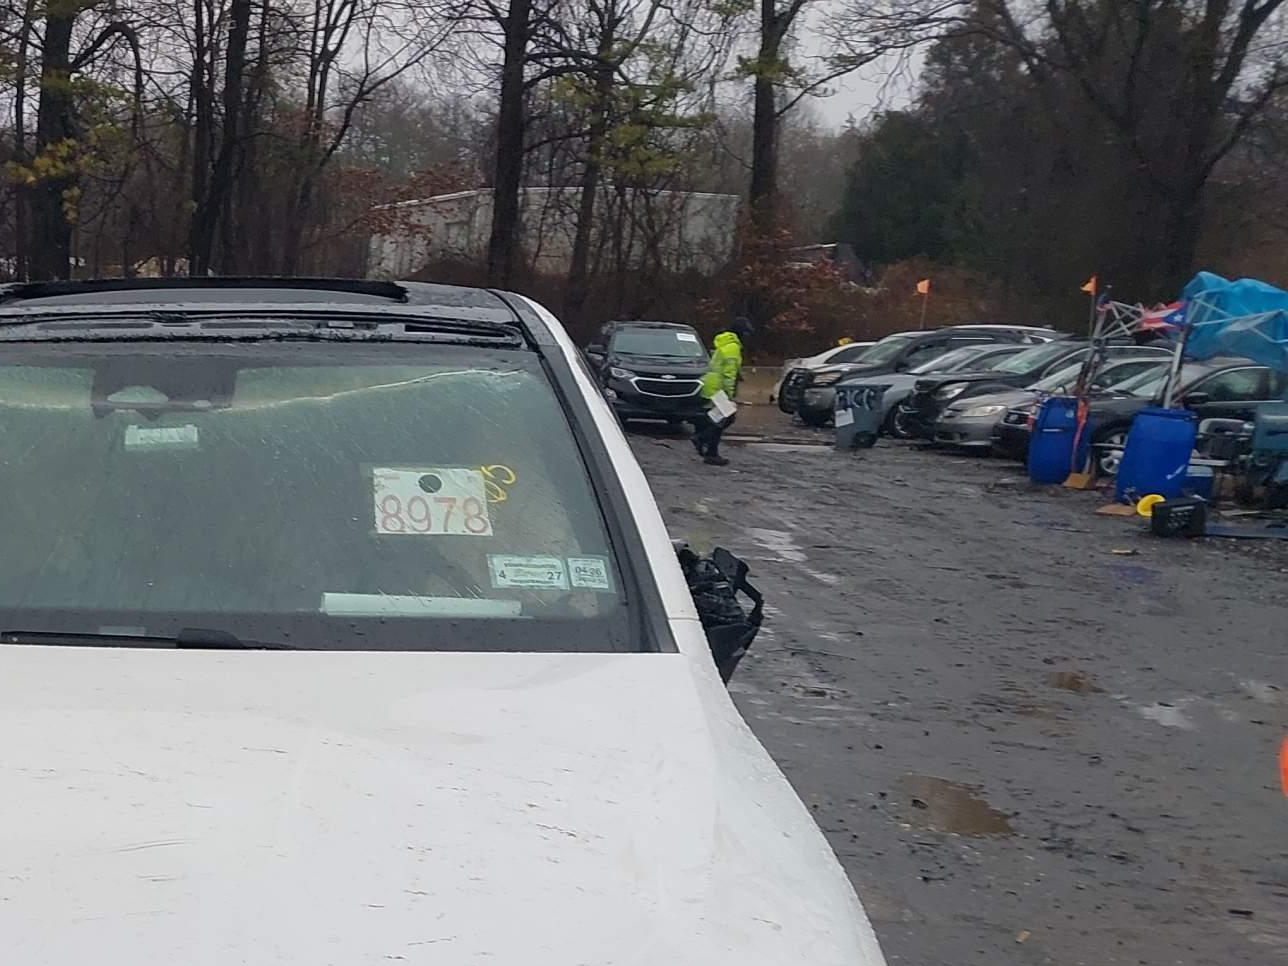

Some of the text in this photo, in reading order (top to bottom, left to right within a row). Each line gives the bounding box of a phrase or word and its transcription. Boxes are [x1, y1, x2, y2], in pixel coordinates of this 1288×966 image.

[381, 494, 489, 533] 8978
[498, 569, 562, 580] 4 27
